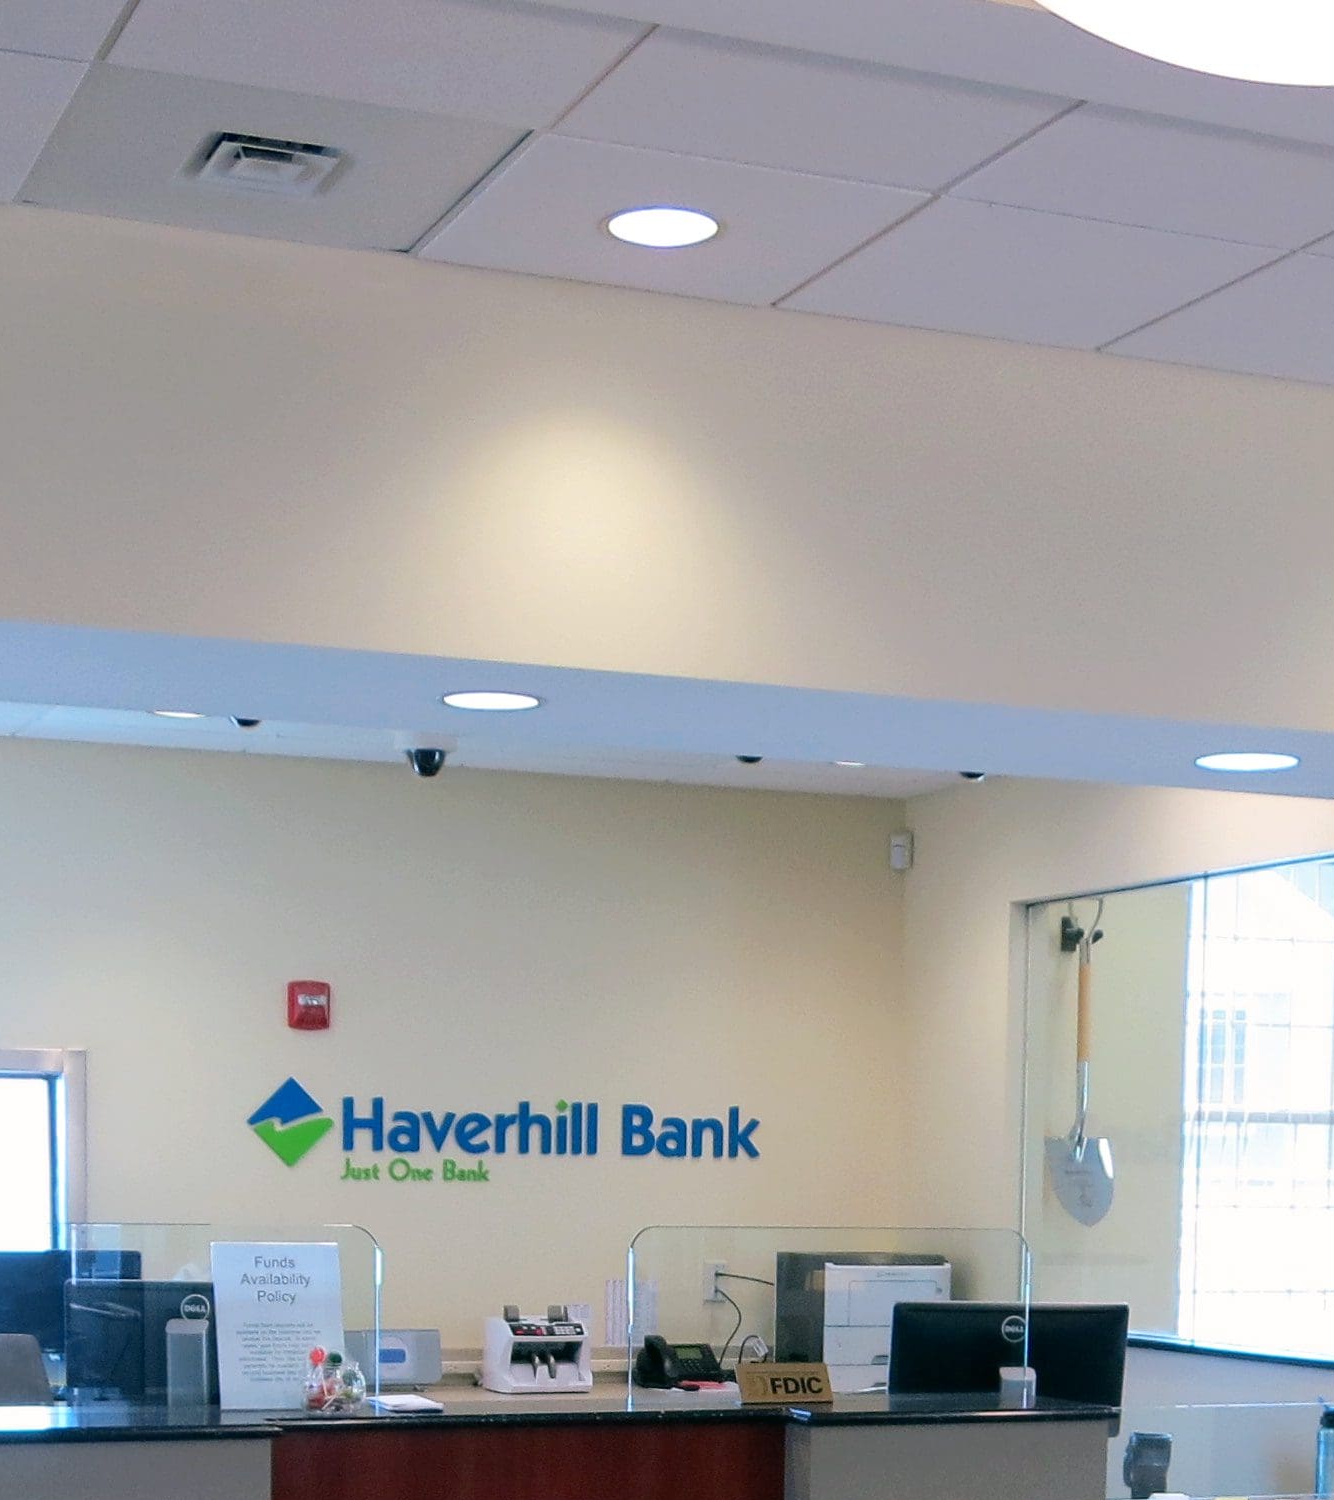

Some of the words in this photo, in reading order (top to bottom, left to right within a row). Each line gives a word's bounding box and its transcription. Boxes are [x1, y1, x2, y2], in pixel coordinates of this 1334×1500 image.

[342, 1096, 598, 1155] Haverhill
[622, 1103, 760, 1159] Bank
[340, 1158, 380, 1182] Just
[388, 1159, 433, 1182] One
[443, 1160, 490, 1183] Bank
[255, 1257, 296, 1268] Funds
[241, 1273, 311, 1288] Availability
[258, 1290, 296, 1305] Policy
[769, 1376, 823, 1394] FDIC
